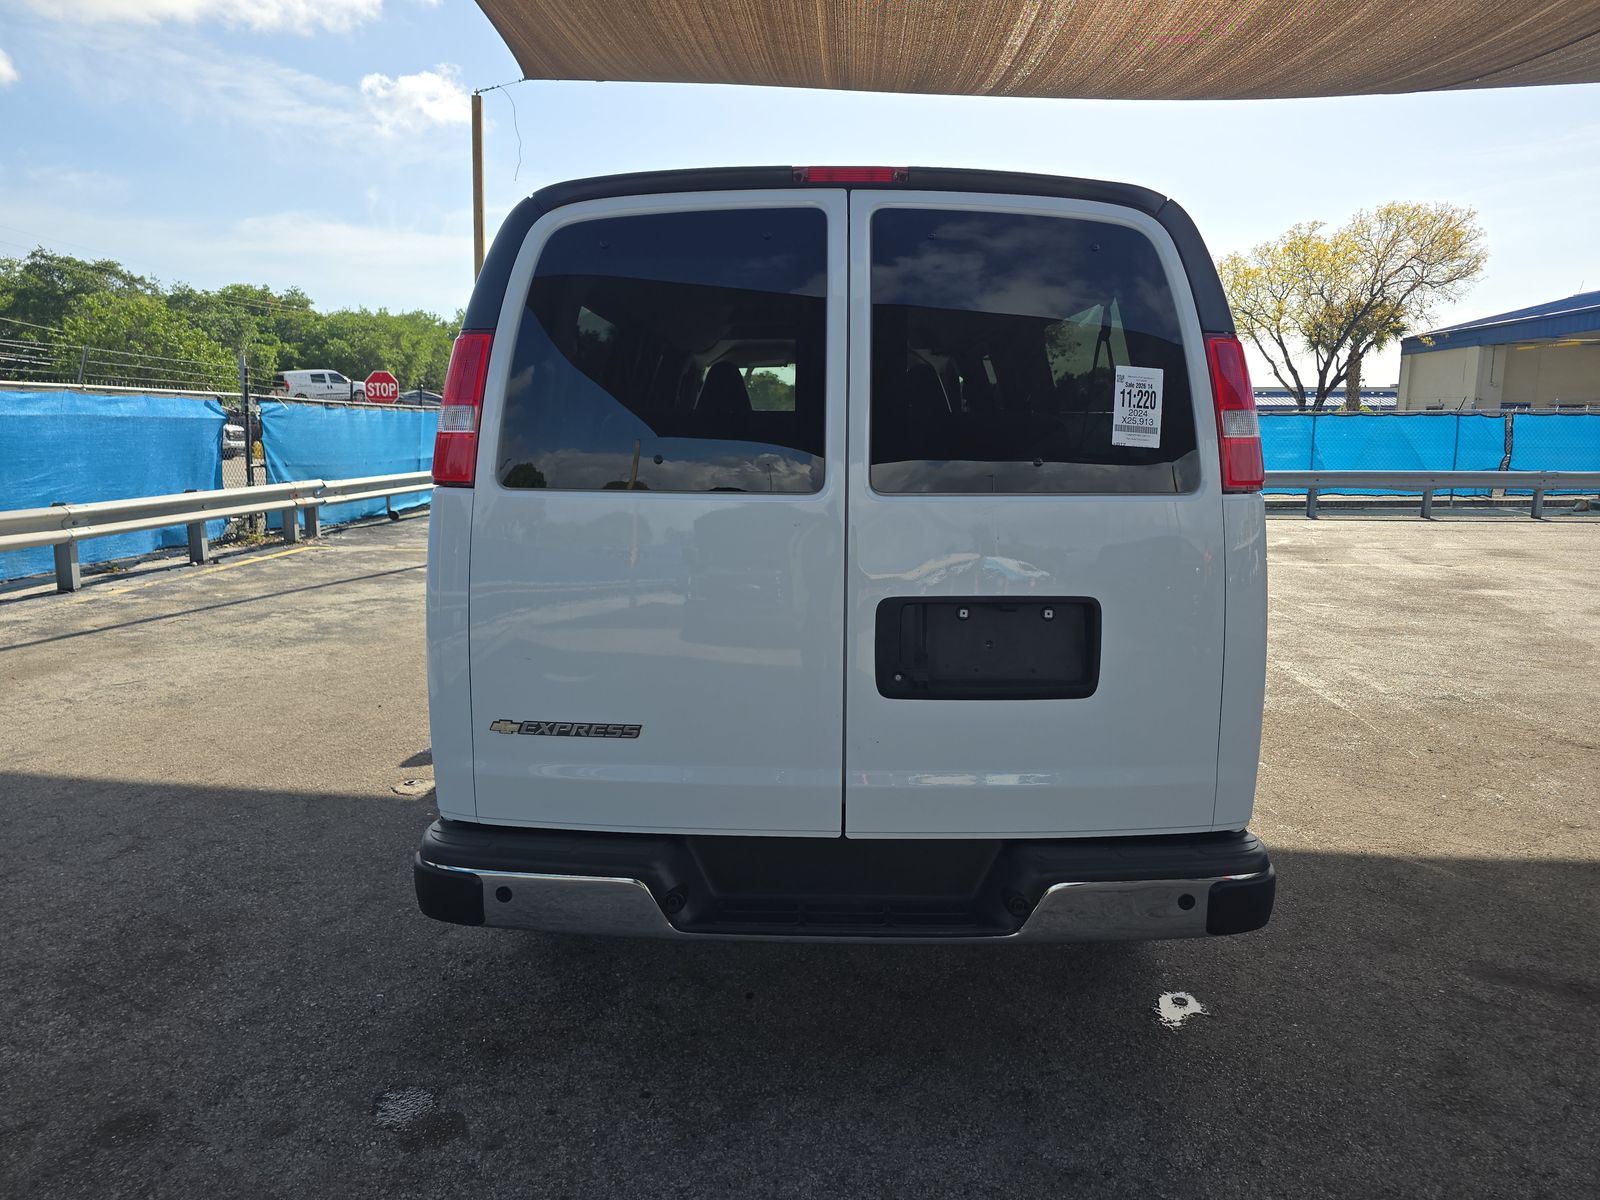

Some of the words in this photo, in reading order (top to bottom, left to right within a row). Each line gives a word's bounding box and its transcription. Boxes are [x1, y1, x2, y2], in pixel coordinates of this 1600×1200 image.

[367, 382, 397, 397] STOP
[1125, 381, 1135, 389] Sale
[1120, 388, 1157, 410] 11:220
[1128, 409, 1148, 417] 2024
[1121, 416, 1154, 426] X25,913
[518, 721, 642, 738] EXPRESS
